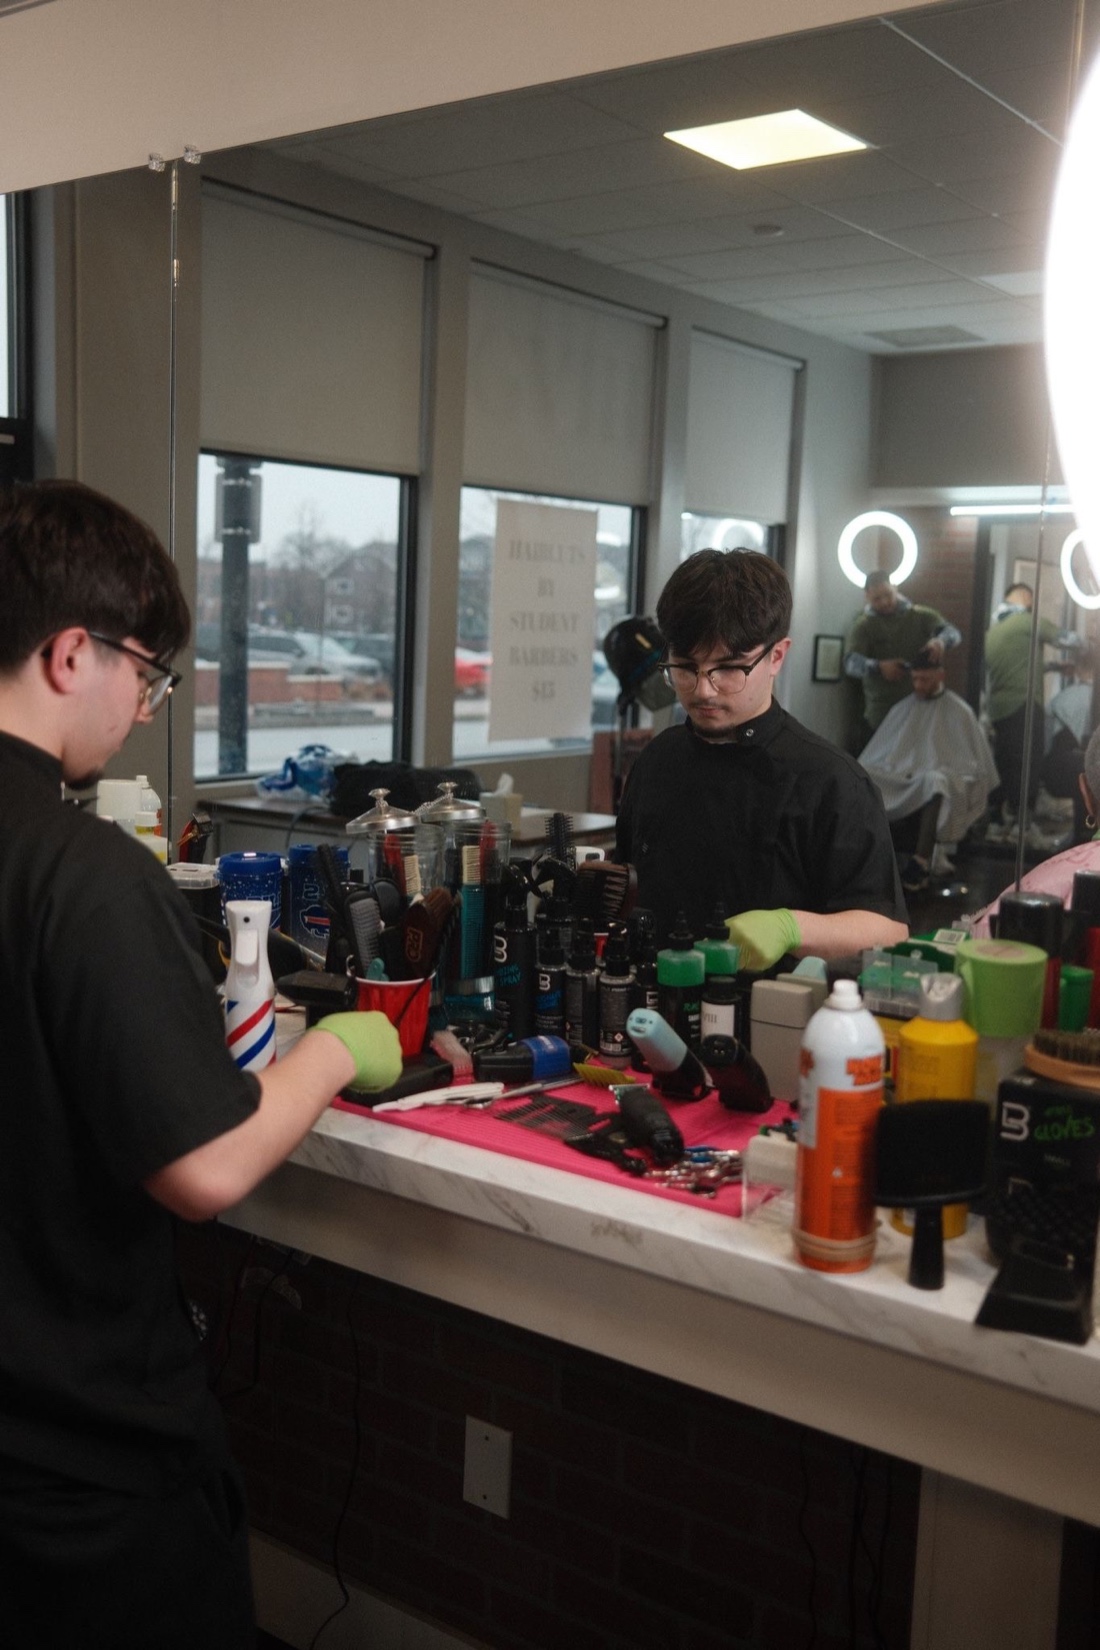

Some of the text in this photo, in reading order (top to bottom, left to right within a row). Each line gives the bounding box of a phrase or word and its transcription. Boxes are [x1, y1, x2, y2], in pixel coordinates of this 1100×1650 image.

[508, 540, 586, 565] HAIRCUTS
[537, 577, 555, 598] BY
[509, 611, 580, 633] STUDENT
[508, 646, 579, 667] BARBERS
